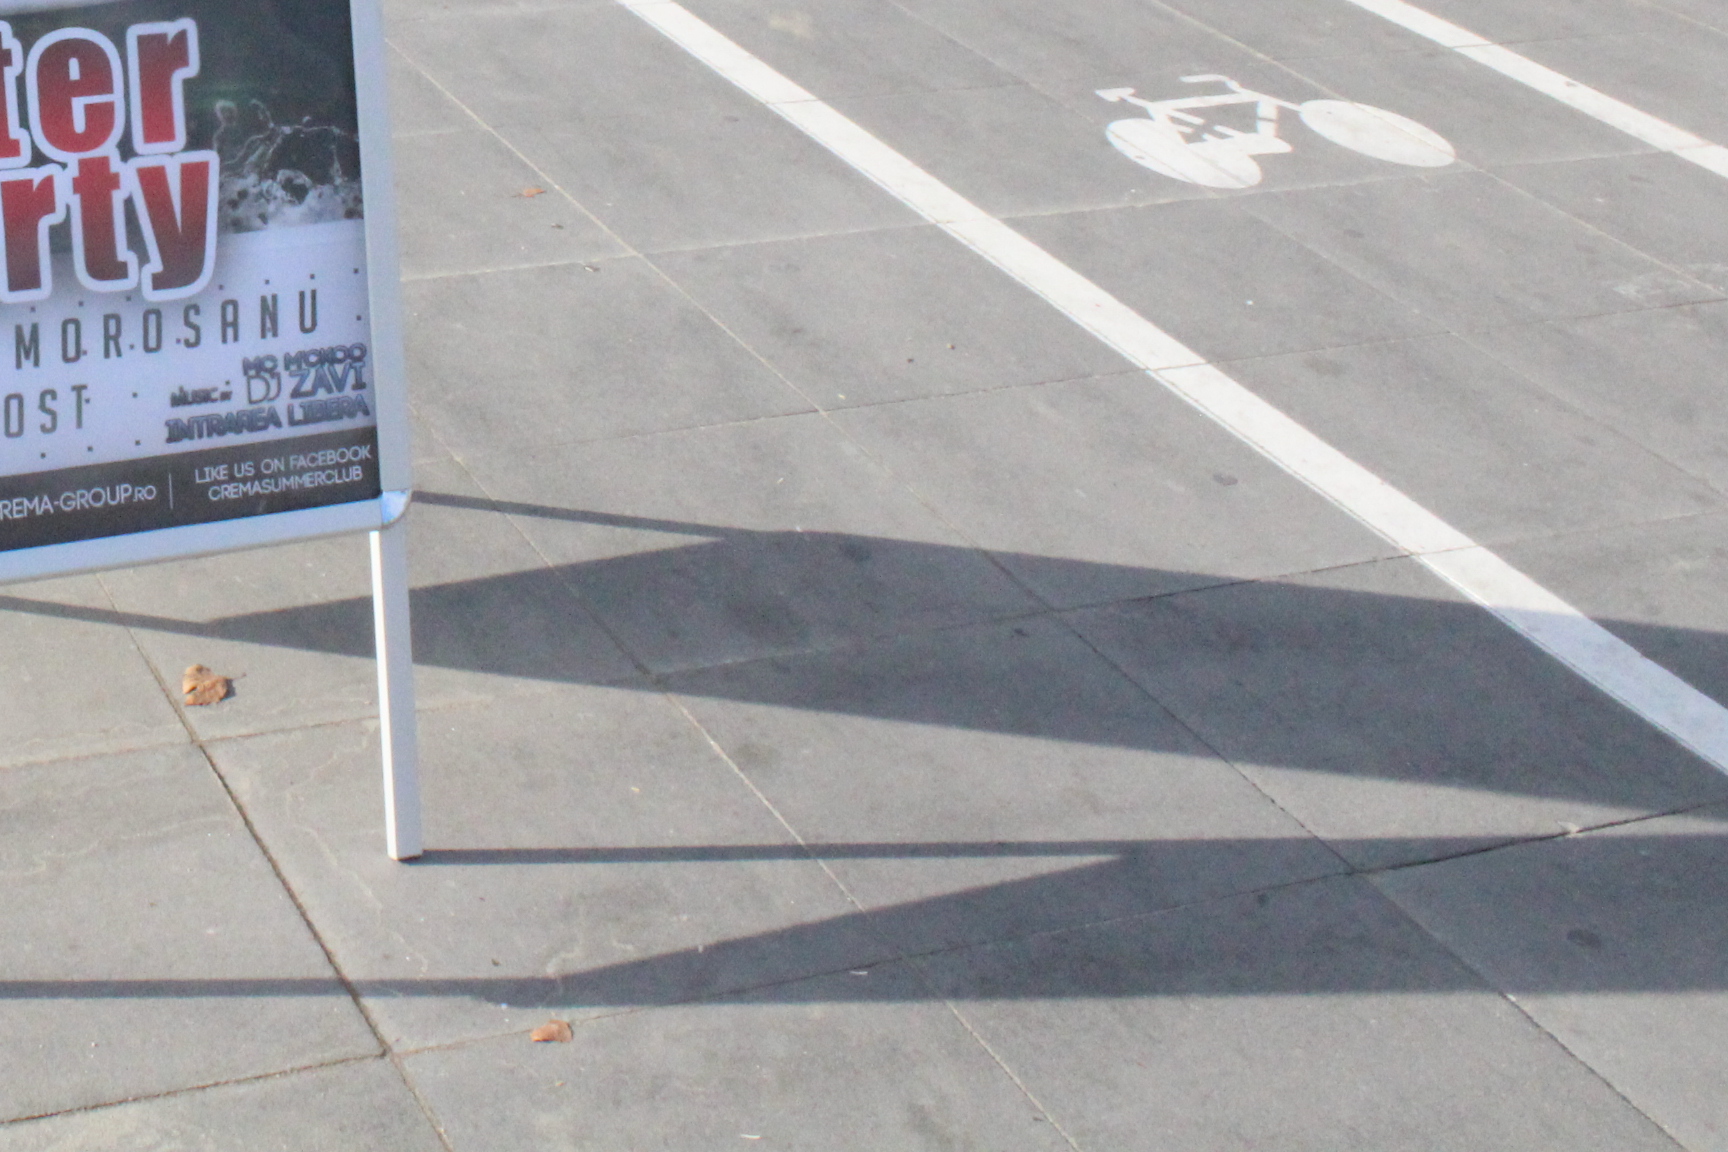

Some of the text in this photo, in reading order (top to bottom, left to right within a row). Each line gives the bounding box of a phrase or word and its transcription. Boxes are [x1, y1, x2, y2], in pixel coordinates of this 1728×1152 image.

[15, 288, 320, 371] MOROSANU
[247, 371, 282, 404] DJ
[289, 361, 368, 399] ZAVI
[165, 393, 371, 444] INTRAREA LIBERA
[194, 444, 373, 484] LIKE US ON FACEBOOK
[208, 465, 364, 501] CREMASUMMERCLUB
